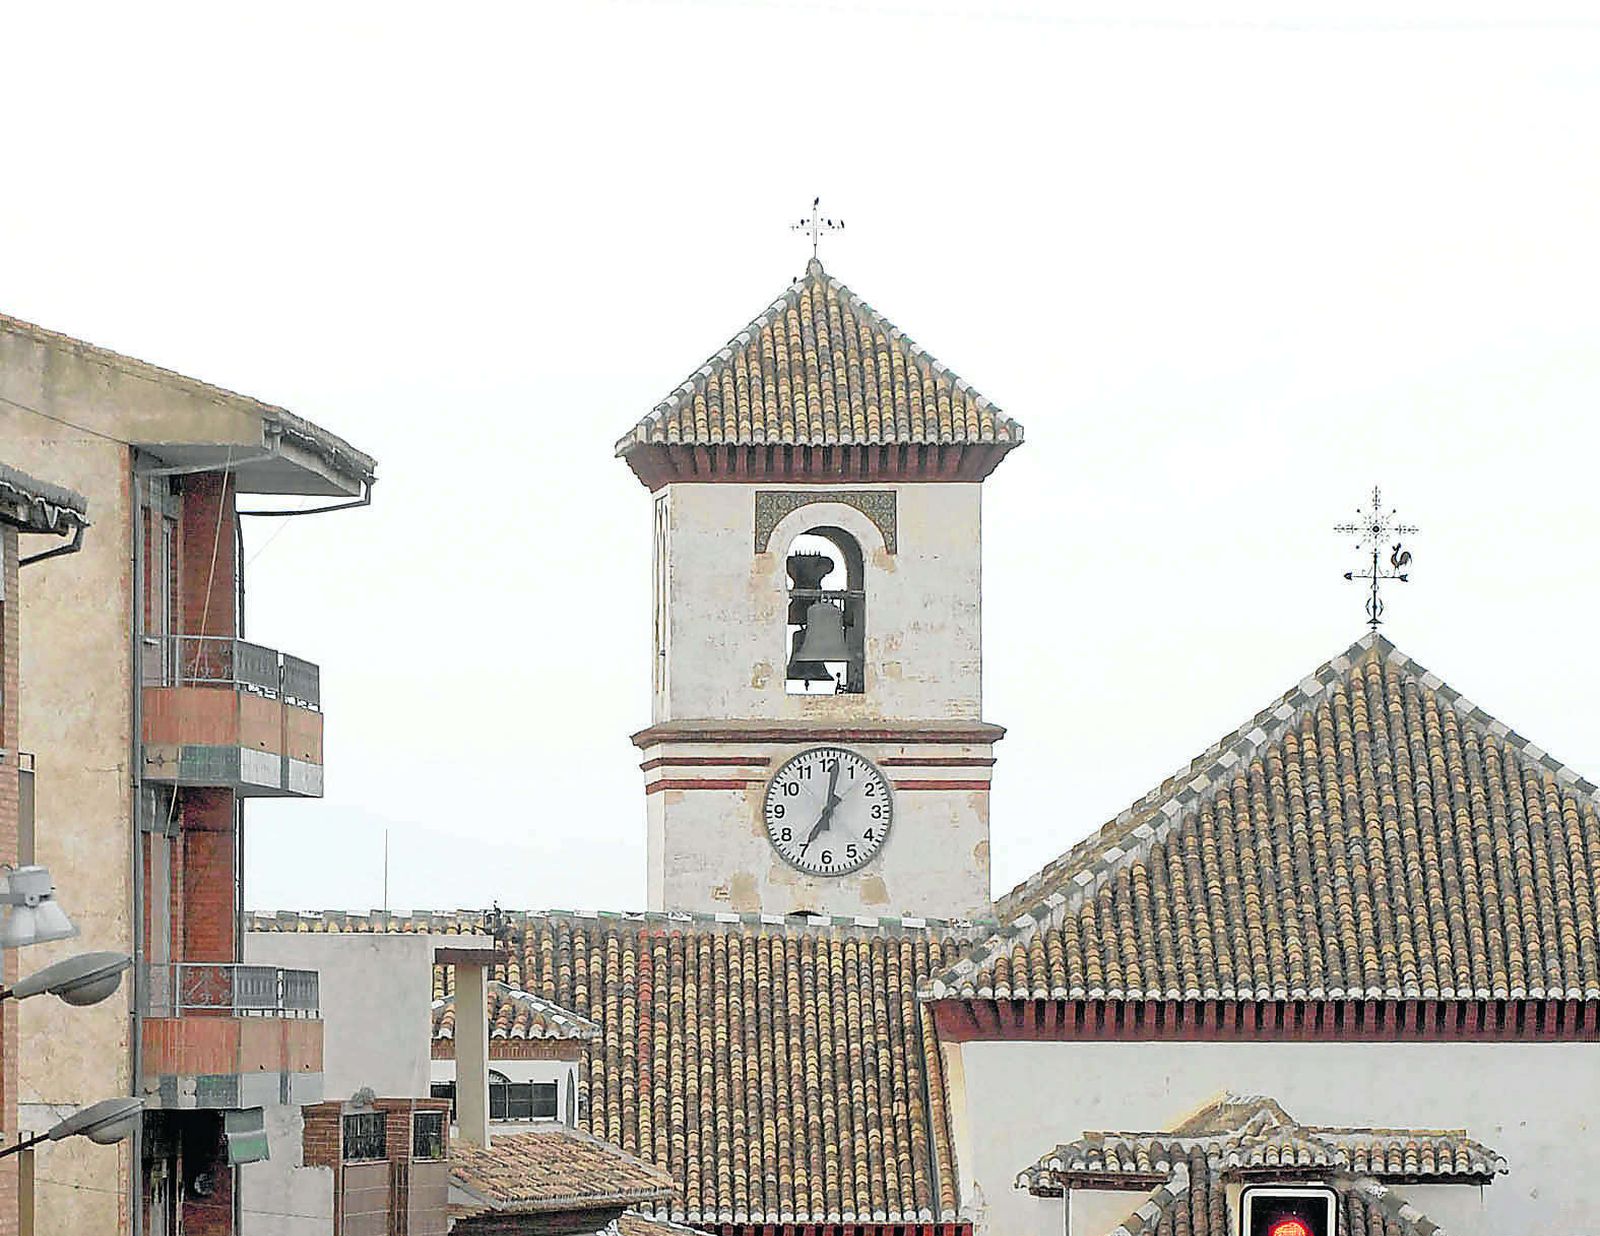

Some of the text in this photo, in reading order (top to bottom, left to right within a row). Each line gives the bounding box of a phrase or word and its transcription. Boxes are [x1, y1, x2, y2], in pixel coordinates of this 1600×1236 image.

[819, 759, 836, 772] 12
[797, 766, 811, 779] 11
[847, 766, 854, 779] 1
[781, 782, 799, 796] 10
[865, 783, 874, 796] 2
[774, 805, 785, 818] 9
[871, 805, 881, 818] 3
[781, 828, 791, 841] 8
[863, 828, 874, 841] 4
[799, 843, 809, 857] 7
[846, 845, 857, 858] 5
[822, 851, 832, 864] 6
